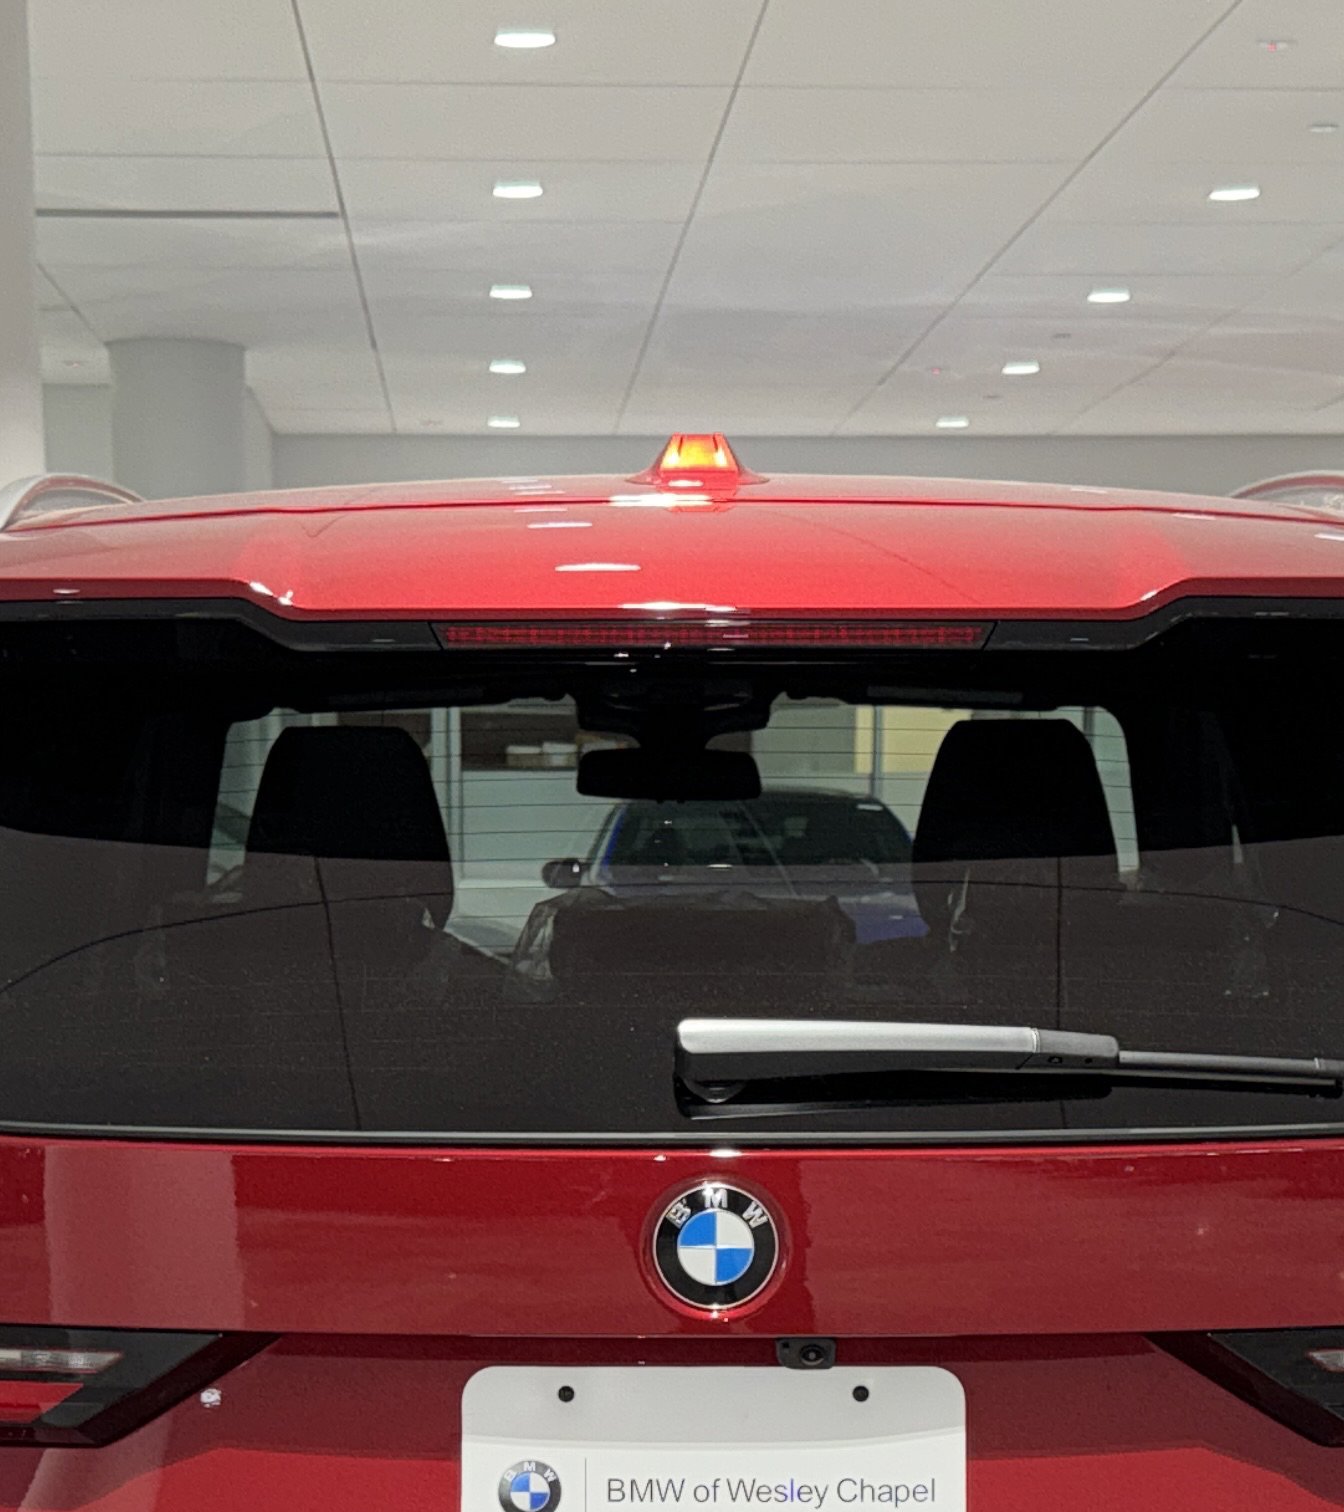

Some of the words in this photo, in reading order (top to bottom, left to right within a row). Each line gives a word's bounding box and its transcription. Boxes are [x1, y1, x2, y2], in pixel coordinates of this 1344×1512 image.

[666, 1187, 768, 1229] BMW
[504, 1461, 557, 1482] BMW
[607, 1478, 686, 1503] BMW
[692, 1478, 721, 1503] of
[726, 1478, 829, 1509] Wesley
[836, 1478, 936, 1508] Chapel
